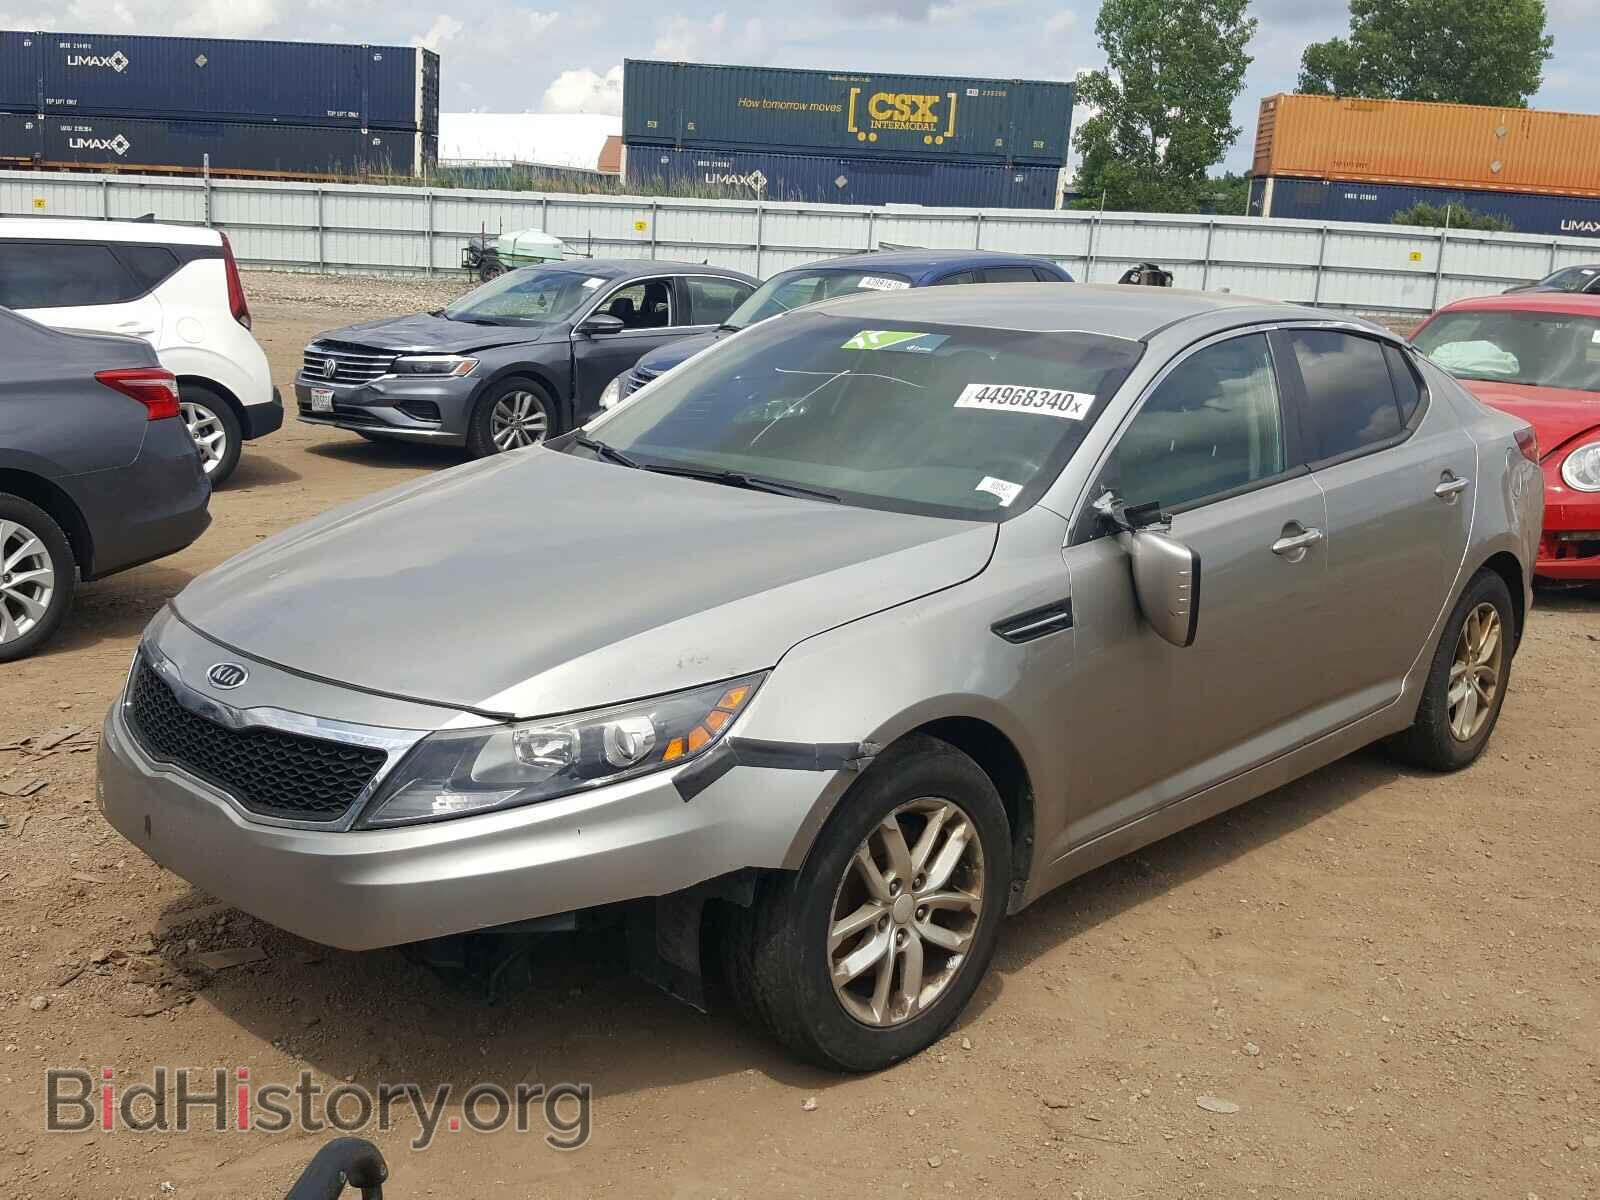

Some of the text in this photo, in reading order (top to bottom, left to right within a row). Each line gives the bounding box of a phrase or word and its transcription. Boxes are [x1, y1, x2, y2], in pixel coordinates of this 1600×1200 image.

[737, 97, 842, 113] How tomorrow moves
[868, 92, 940, 122] CSX
[870, 120, 937, 132] INTERMODAL
[212, 665, 241, 685] KIA
